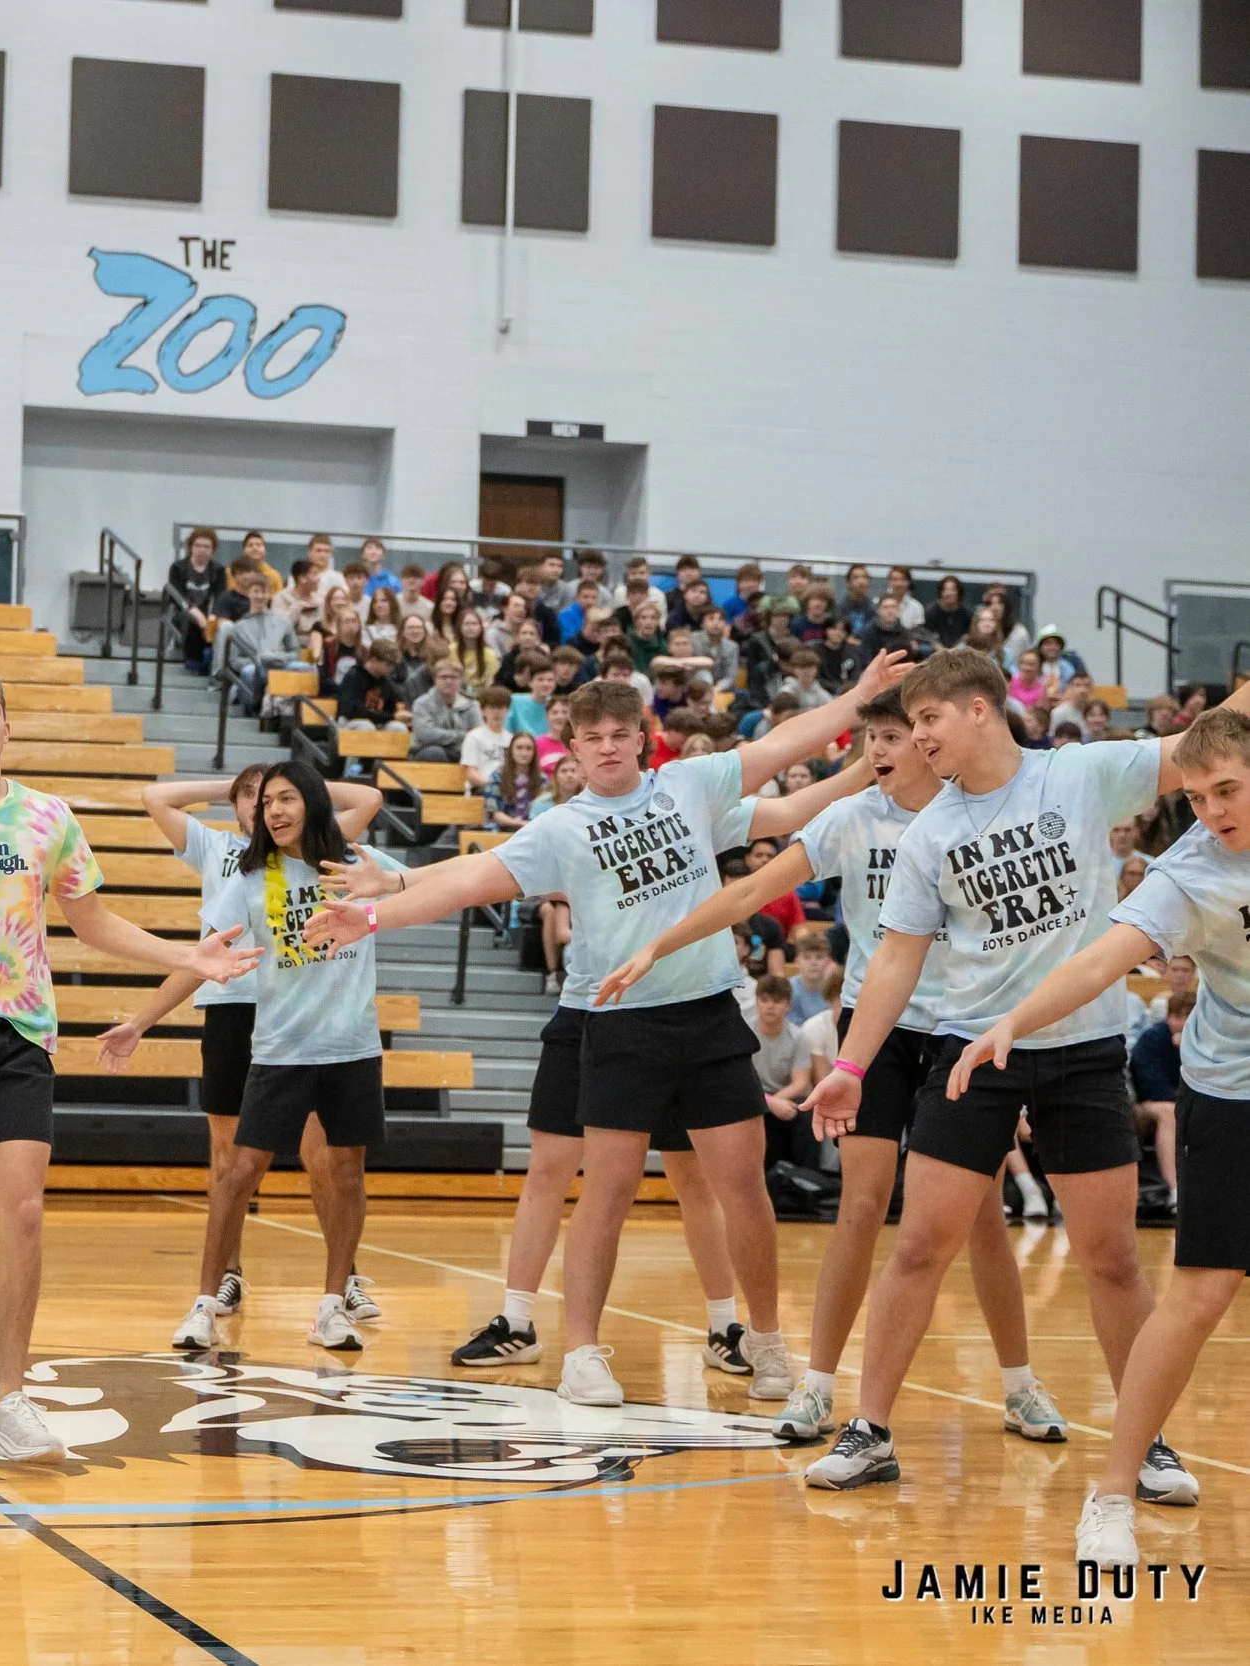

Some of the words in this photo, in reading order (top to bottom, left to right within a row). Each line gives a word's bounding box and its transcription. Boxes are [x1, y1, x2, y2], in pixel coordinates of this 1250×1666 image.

[178, 236, 237, 271] THE
[586, 815, 619, 842] IN
[592, 812, 691, 870] TIGERETTE
[946, 840, 984, 874] IN
[988, 822, 1035, 858] MY
[615, 847, 688, 894] ERA
[616, 890, 650, 910] BOYS
[651, 873, 689, 897] DANCE
[957, 841, 1077, 908] TIGERETTE
[981, 885, 1065, 934] ERA
[982, 935, 1014, 952] BOYS
[1017, 918, 1063, 943] DANCE
